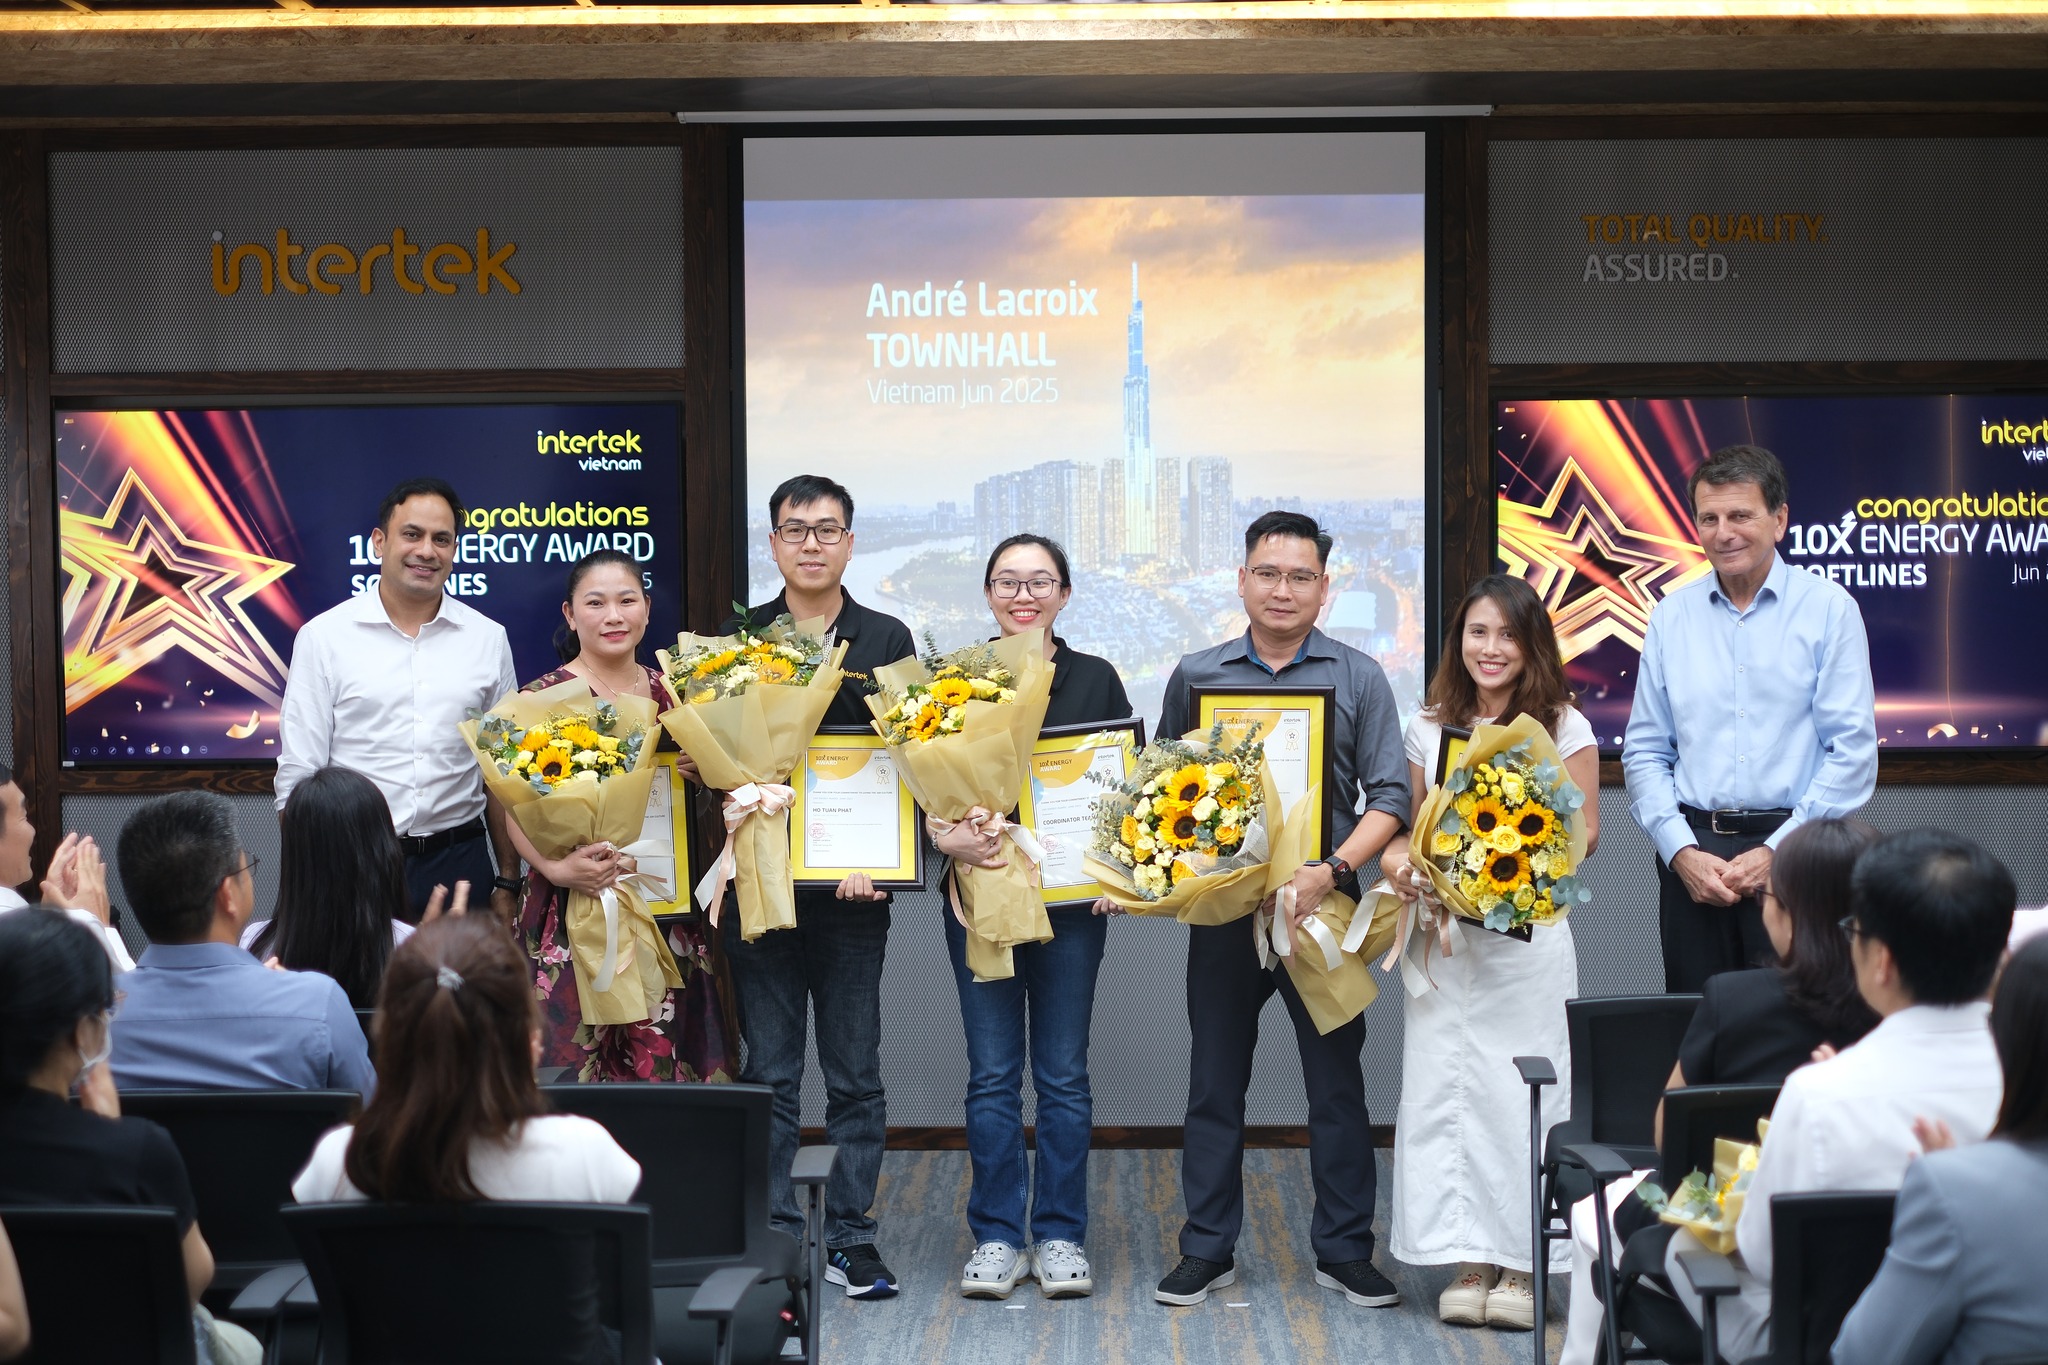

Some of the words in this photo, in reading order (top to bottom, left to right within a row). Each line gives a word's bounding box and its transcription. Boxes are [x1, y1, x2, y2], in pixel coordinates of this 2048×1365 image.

[1582, 214, 1681, 244] TOTAL
[211, 227, 521, 296] intertek
[1583, 253, 1740, 282] ASSURED.
[866, 280, 967, 317] André
[978, 280, 1098, 317] Lacroix
[866, 332, 1056, 368] TOWNHALL
[866, 379, 955, 404] Vietnam
[960, 378, 993, 409] Jun
[1000, 377, 1058, 403] 2025
[537, 429, 642, 454] intertek
[578, 456, 642, 471] vietnam
[463, 501, 649, 535] gratulations
[1789, 511, 1857, 555] 10X
[1861, 524, 1979, 553] ENERGY
[349, 534, 383, 566] 10
[453, 533, 538, 563] ERGY
[1792, 563, 1927, 586] FTLINES
[2012, 563, 2040, 584] Jun
[844, 670, 868, 680] tertek
[1039, 765, 1062, 773] AWARD
[1050, 759, 1073, 767] ENERGY
[1042, 816, 1081, 826] COORDINATOR
